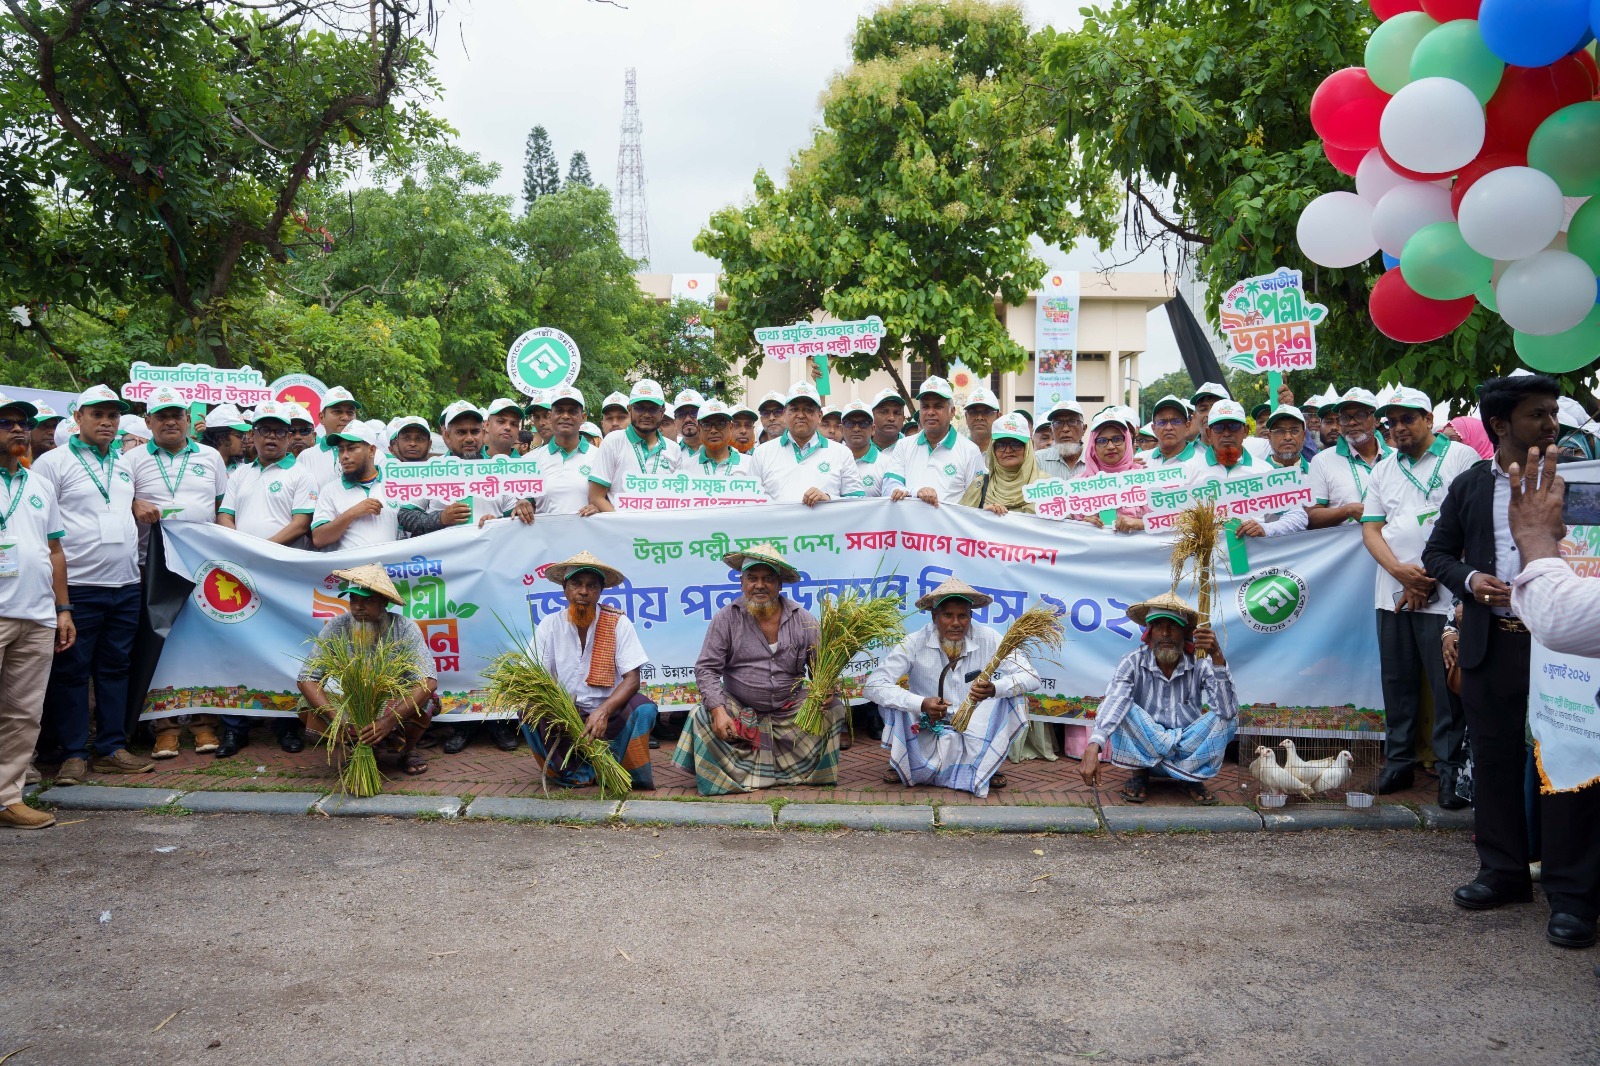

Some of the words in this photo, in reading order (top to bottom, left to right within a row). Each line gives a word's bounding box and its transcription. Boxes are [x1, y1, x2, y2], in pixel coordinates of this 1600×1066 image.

[1260, 271, 1299, 290] জাতীয়
[1257, 287, 1303, 324] পল্লী
[757, 330, 780, 341] তথ্য
[781, 325, 813, 343] প্রযুক্তি
[815, 324, 855, 337] ব্যবহার
[856, 320, 883, 335] করি,
[767, 344, 795, 360] নতুন
[797, 341, 824, 355] রূপে
[826, 336, 852, 354] পল্লী
[854, 335, 877, 352] গড়ি
[1230, 321, 1312, 367] উন্নয়ন
[1275, 347, 1312, 368] দিবস
[133, 365, 225, 384] বিআরডিবি'র
[227, 369, 263, 386] দর্পণ,
[125, 382, 157, 399] গরি
[226, 385, 272, 404] উন্নয়ন
[385, 459, 474, 478] বিআরডিবি'র
[477, 458, 541, 476] অঙ্গীকার,
[385, 481, 423, 501] উন্নত
[426, 482, 466, 502] সমৃদ্ধ
[469, 476, 500, 498] পল্লী
[503, 479, 544, 496] গড়ার
[626, 474, 659, 493] উন্নত
[662, 474, 690, 493] পল্লী
[692, 479, 727, 497] সমৃদ্ধ
[729, 480, 761, 495] দেশ,
[1026, 481, 1068, 500] সমিতি,
[1070, 475, 1122, 493] সংগঠন,
[1122, 471, 1155, 486] সঞ্চয়
[1157, 467, 1187, 480] হলে,
[1151, 489, 1188, 509] উন্নত
[1224, 477, 1263, 497] সমৃদ্ধ
[1266, 470, 1302, 488] দেশ,
[618, 497, 653, 510] সবার
[655, 497, 691, 508] আগে
[1038, 497, 1067, 517] পল্লী
[1069, 493, 1117, 512] উন্নয়নে
[1120, 486, 1146, 505] গতি
[1147, 513, 1180, 530] সবা
[1230, 488, 1312, 515] বাংলাদেশ
[633, 537, 684, 564] উন্নত
[688, 532, 730, 562] পল্লী
[734, 537, 788, 555] সদ্ধ
[794, 534, 841, 554] দেশ,
[845, 530, 898, 551] সবার
[901, 531, 951, 554] আগে
[955, 537, 1059, 565] বাংলাদেশ
[383, 555, 442, 578] জাতীয়
[522, 573, 535, 586] ৬
[525, 577, 669, 630] জতীয়
[1039, 592, 1146, 640] ২০২
[1252, 623, 1286, 632] BRDB
[1548, 664, 1567, 679] জুলাই
[1568, 668, 1591, 682] ২০২৬
